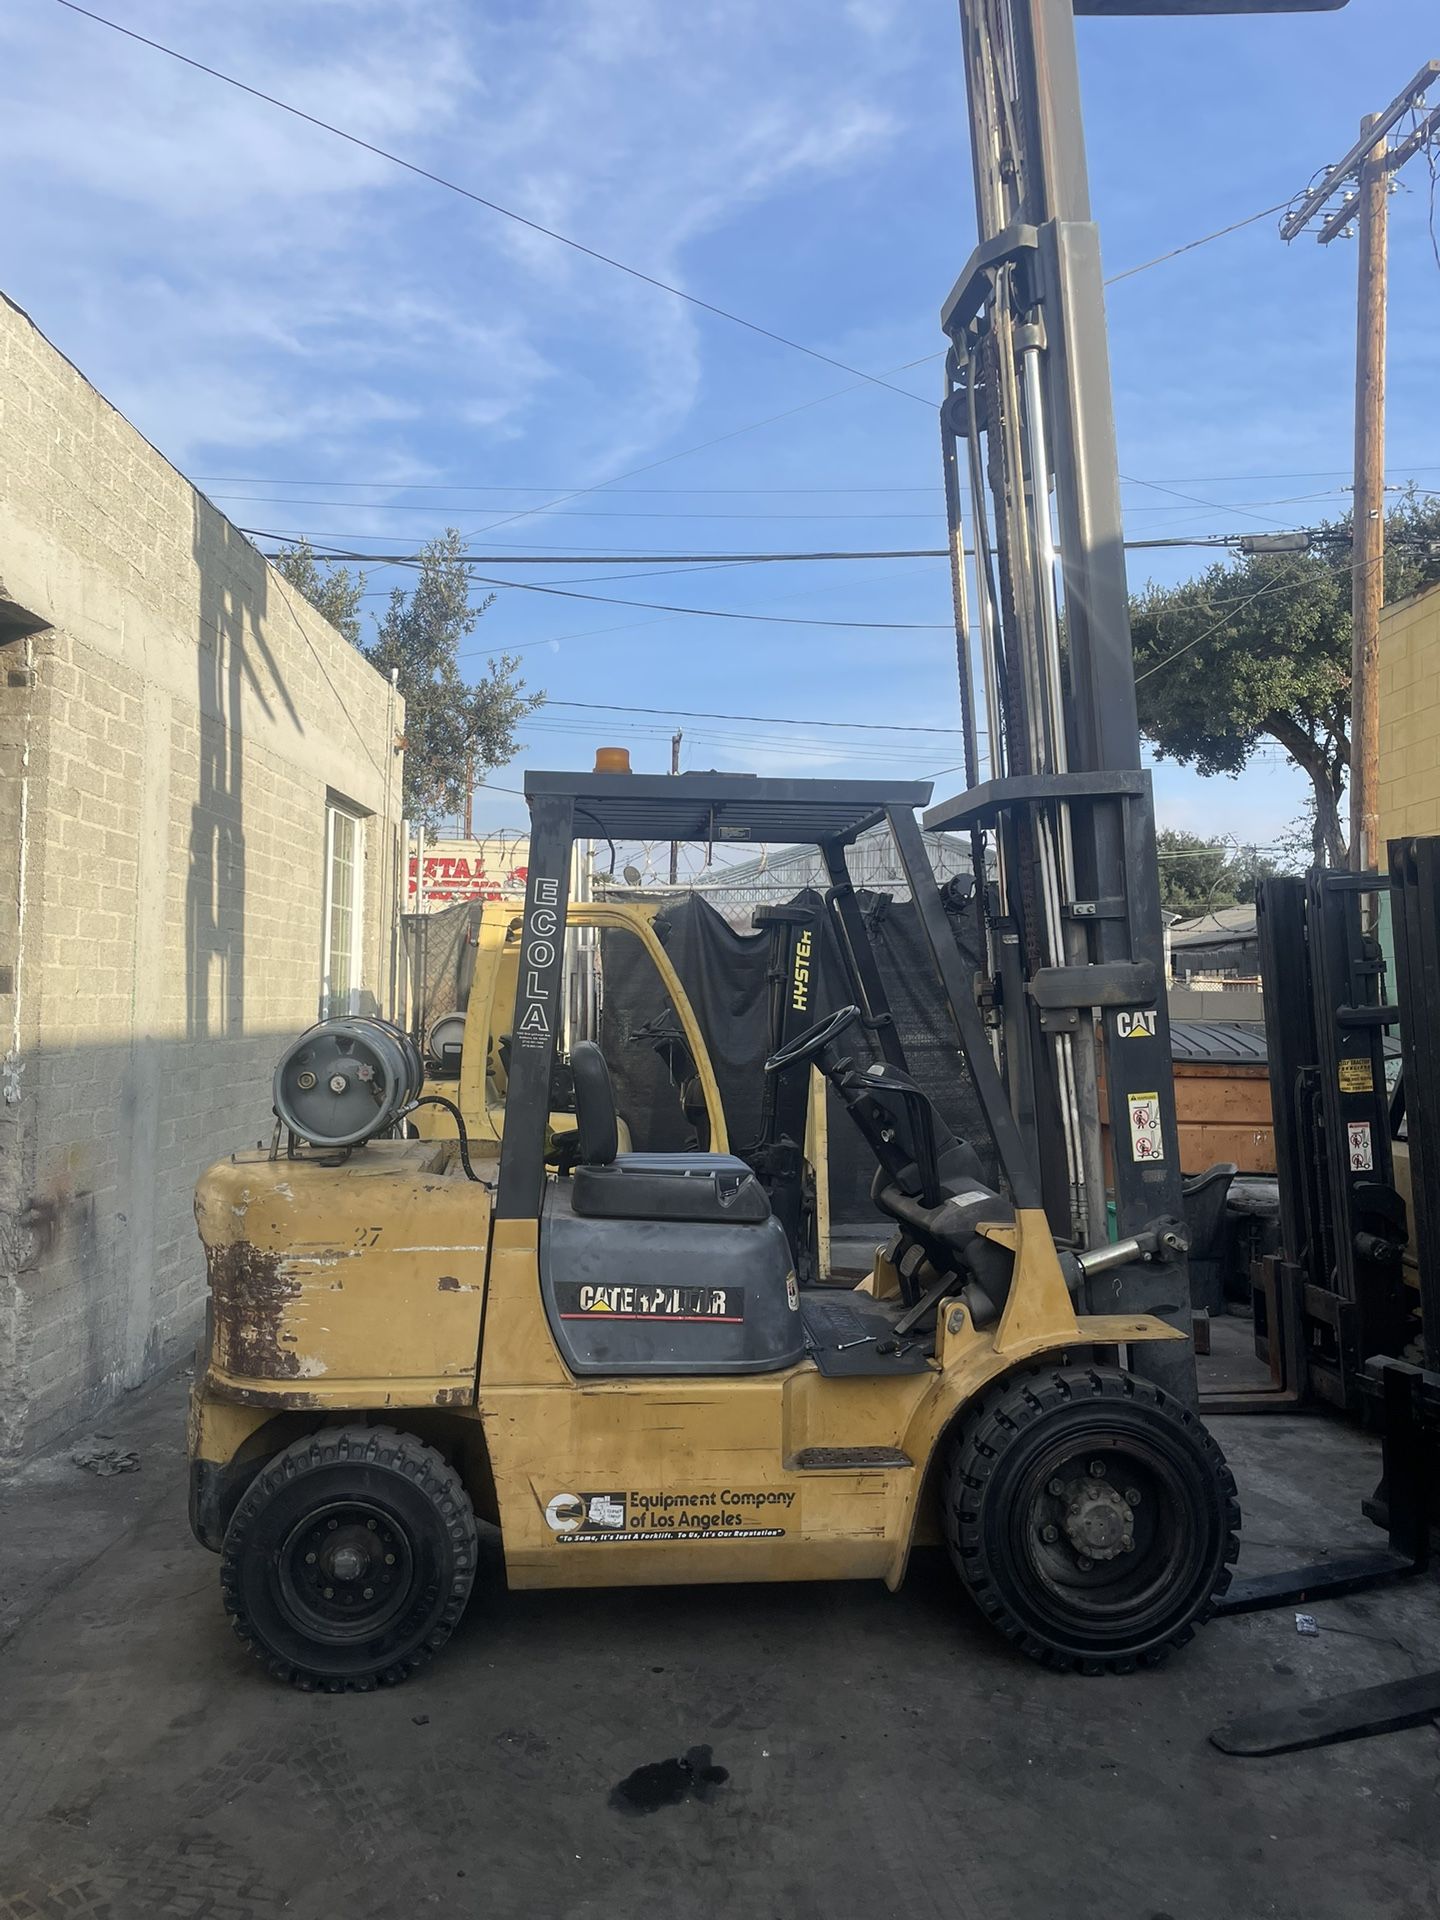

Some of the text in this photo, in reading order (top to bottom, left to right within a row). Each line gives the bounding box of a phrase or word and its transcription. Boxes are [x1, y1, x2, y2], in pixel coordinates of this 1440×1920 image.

[520, 878, 559, 1031] ECOLA
[793, 930, 812, 1011] HYSTER
[1116, 1011, 1157, 1038] CAT
[354, 1227, 383, 1247] 27
[580, 1286, 727, 1314] CATEPLR
[630, 1489, 796, 1511] Equipment Company
[630, 1511, 646, 1528] of
[650, 1511, 675, 1528] Los
[678, 1509, 742, 1530] Angeles
[632, 1532, 639, 1540] A
[677, 1531, 687, 1539] To
[702, 1530, 716, 1538] It's
[717, 1530, 733, 1538] Our
